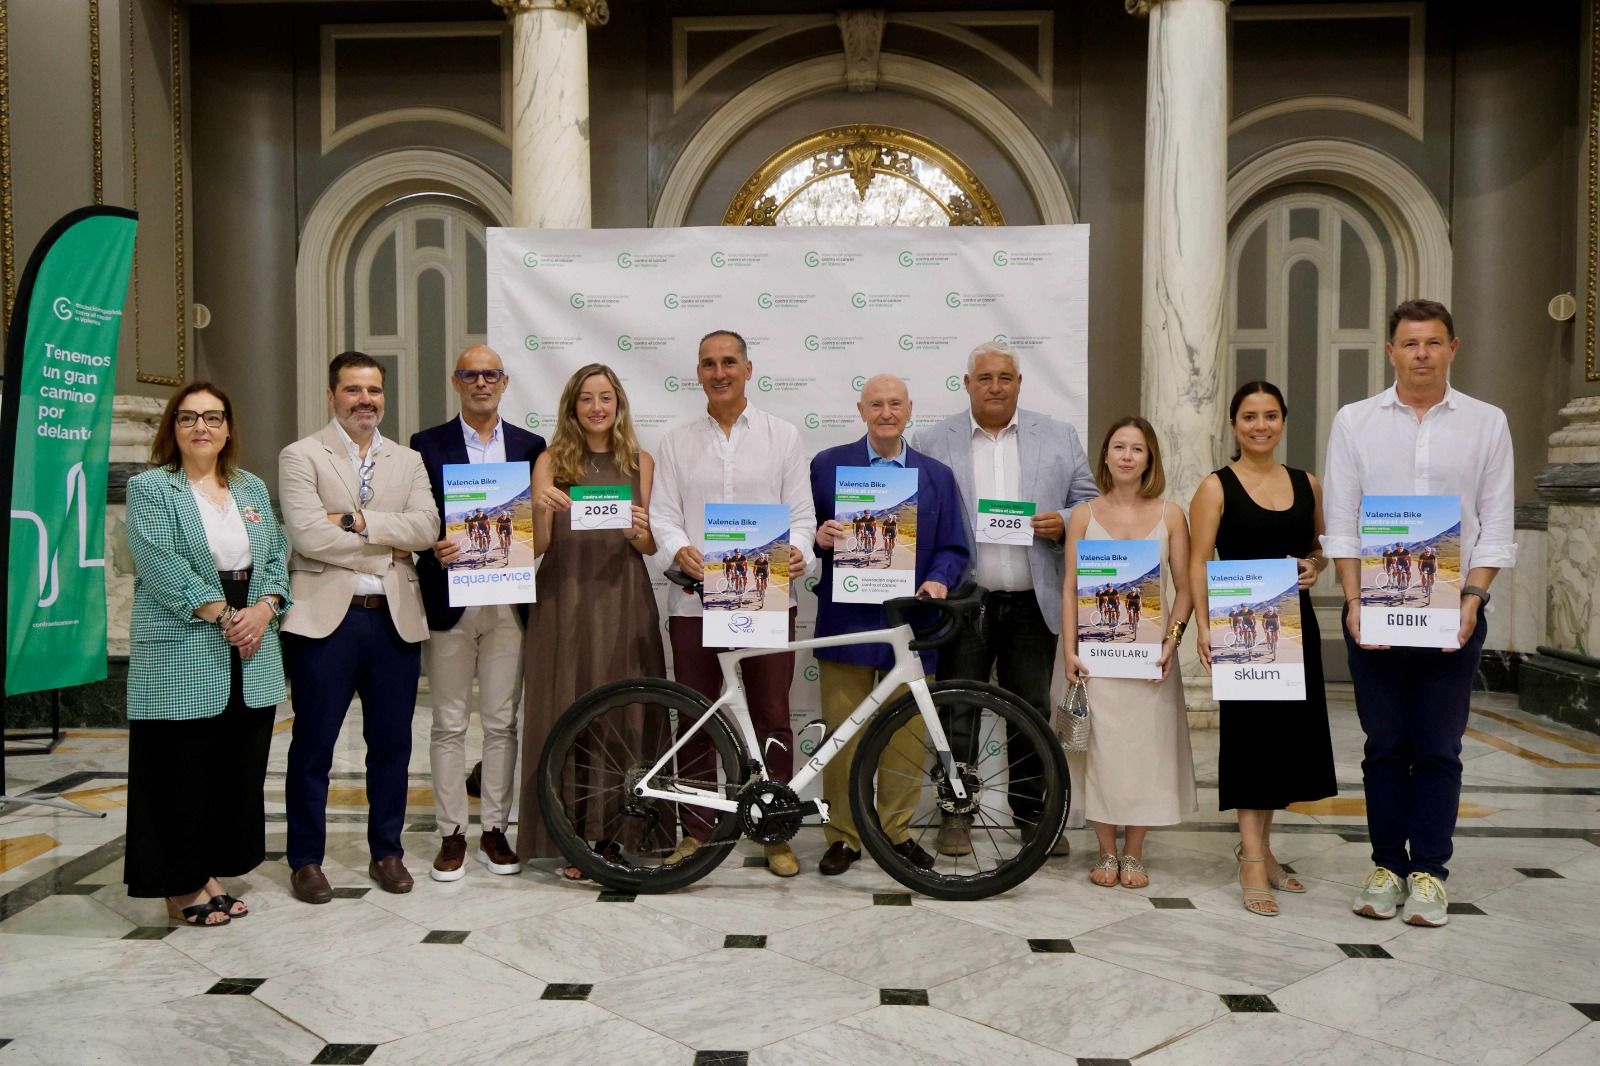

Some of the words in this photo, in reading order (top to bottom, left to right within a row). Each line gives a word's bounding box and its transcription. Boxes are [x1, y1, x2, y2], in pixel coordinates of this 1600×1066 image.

[45, 343, 111, 367] Tenemos
[43, 366, 60, 379] un
[65, 370, 97, 385] gran
[40, 386, 96, 403] camino
[38, 405, 65, 420] por
[447, 478, 479, 486] Valencia
[585, 504, 618, 516] 2026
[990, 518, 1021, 529] 2026
[1210, 574, 1244, 582] Valencia
[1388, 614, 1428, 626] GOBIK
[1090, 648, 1148, 658] SINGULARU
[1234, 667, 1280, 681] sklum
